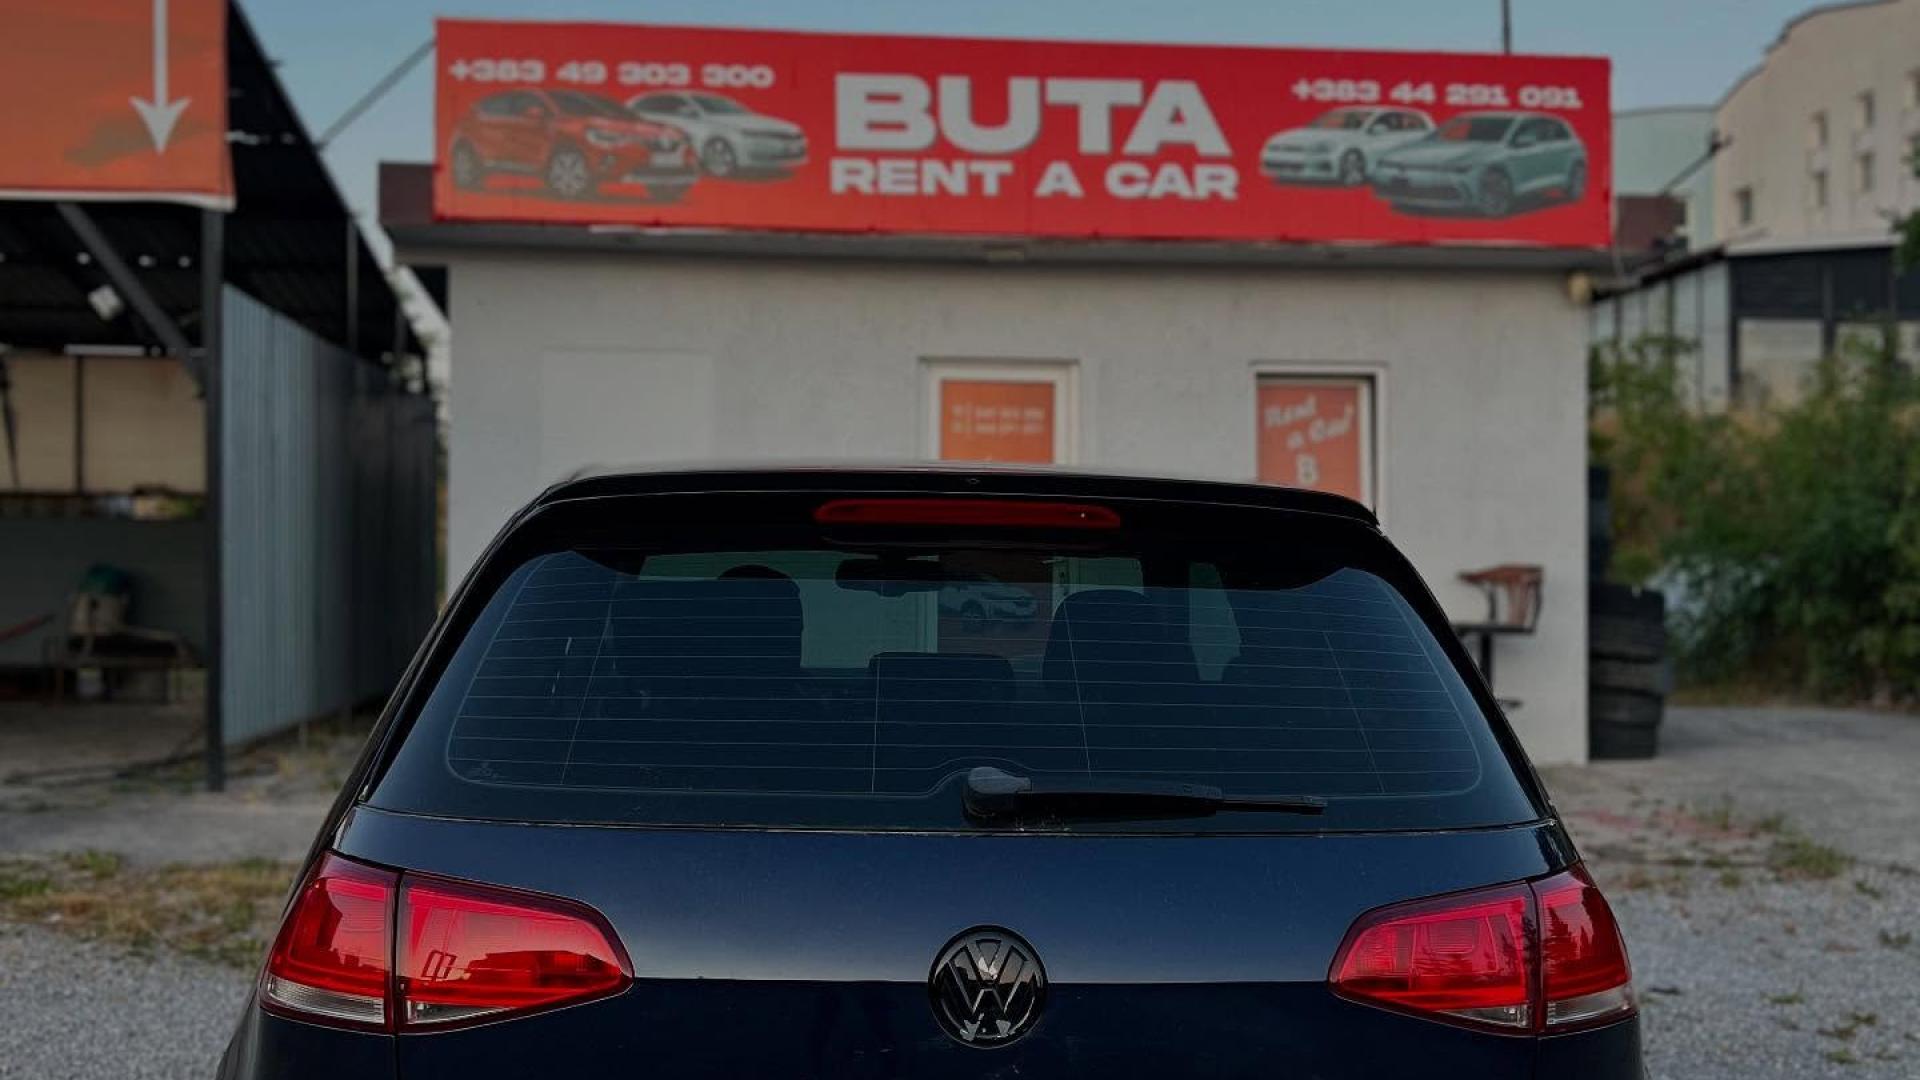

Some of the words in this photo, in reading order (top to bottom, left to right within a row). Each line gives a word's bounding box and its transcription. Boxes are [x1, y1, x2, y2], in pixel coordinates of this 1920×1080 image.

[450, 59, 545, 83] +383
[556, 61, 607, 84] 49
[618, 63, 691, 86] 303
[702, 65, 775, 88] 300
[1291, 79, 1380, 103] +383
[1388, 82, 1436, 105] 44
[834, 73, 1232, 157] BUTA
[830, 158, 1014, 196] RENT
[1035, 161, 1085, 198] A
[1105, 163, 1240, 200] CAR
